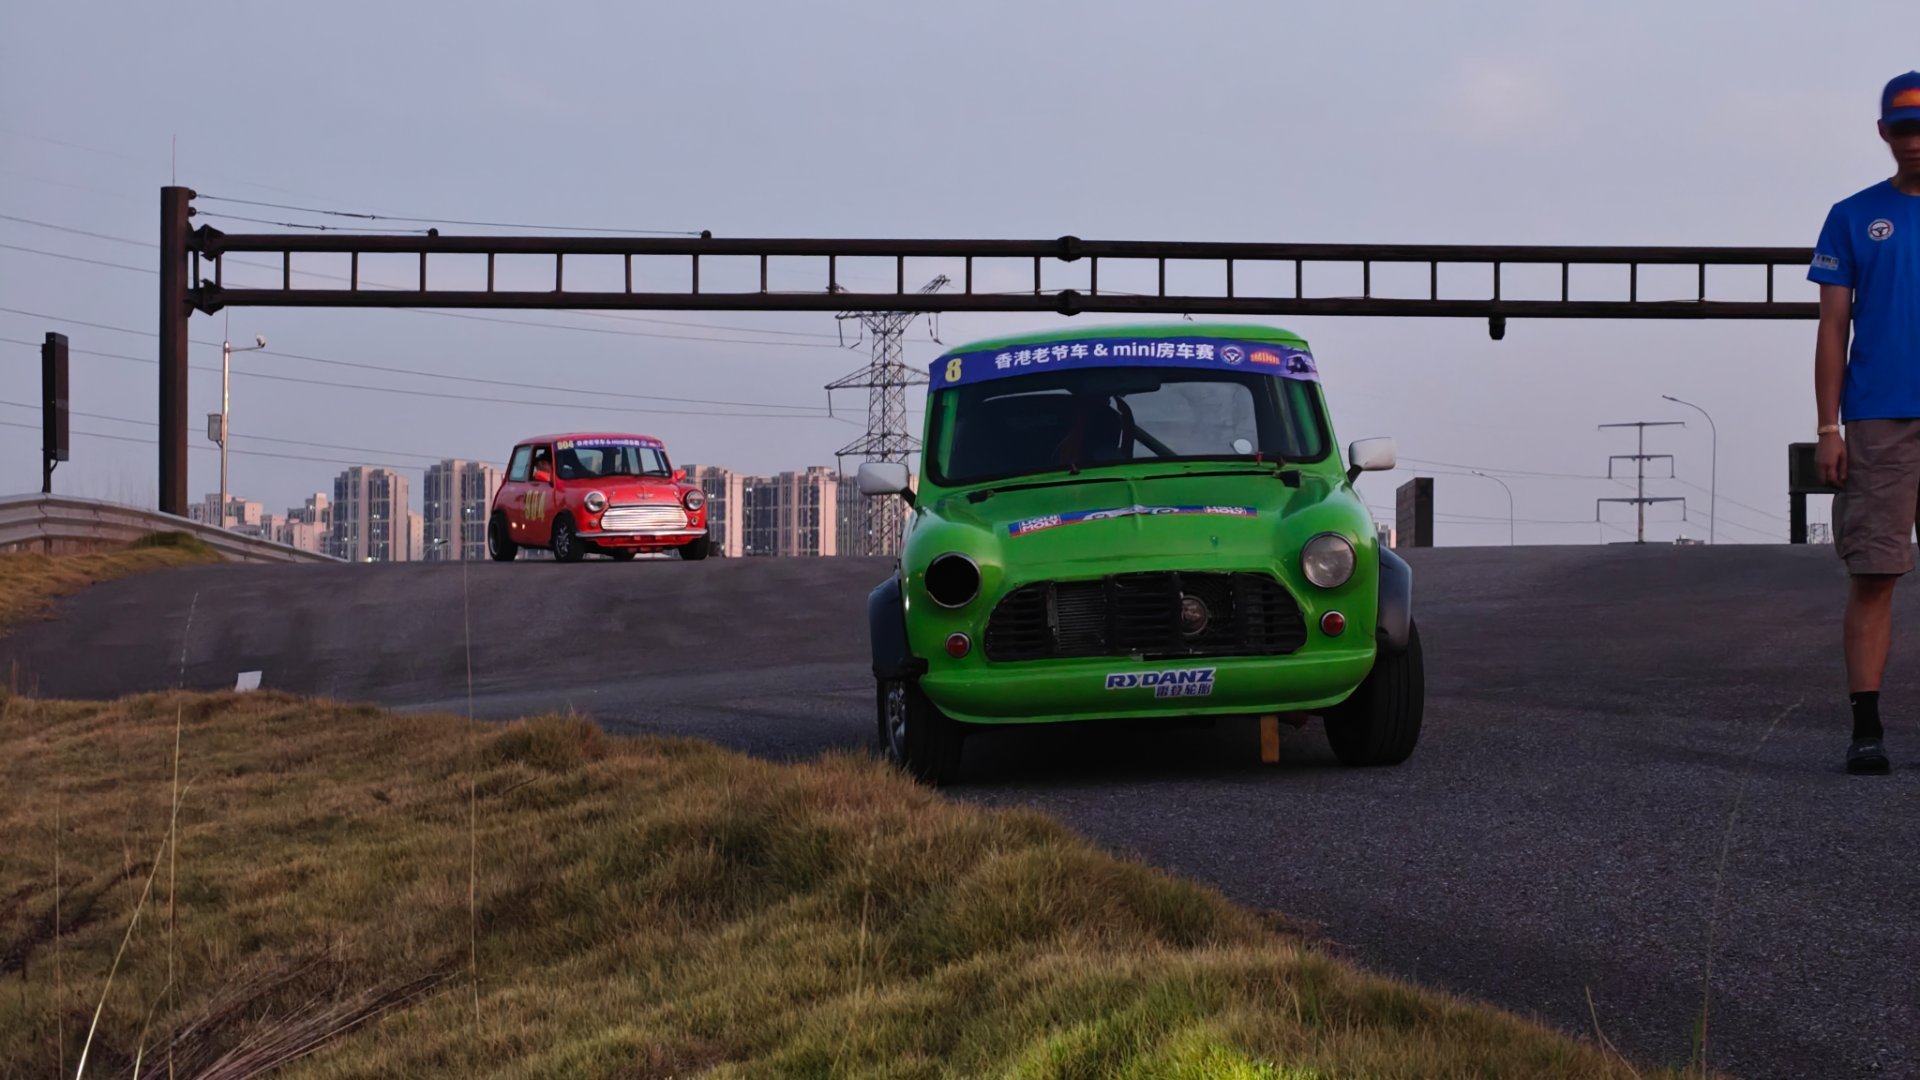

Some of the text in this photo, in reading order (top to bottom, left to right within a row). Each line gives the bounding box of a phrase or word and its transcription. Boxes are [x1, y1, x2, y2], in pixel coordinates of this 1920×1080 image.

[994, 343, 1089, 369] 香港老爷车
[1093, 343, 1109, 357] &
[945, 358, 962, 382] 8
[1022, 519, 1060, 532] MOLY
[1106, 669, 1215, 688] RYDANZ
